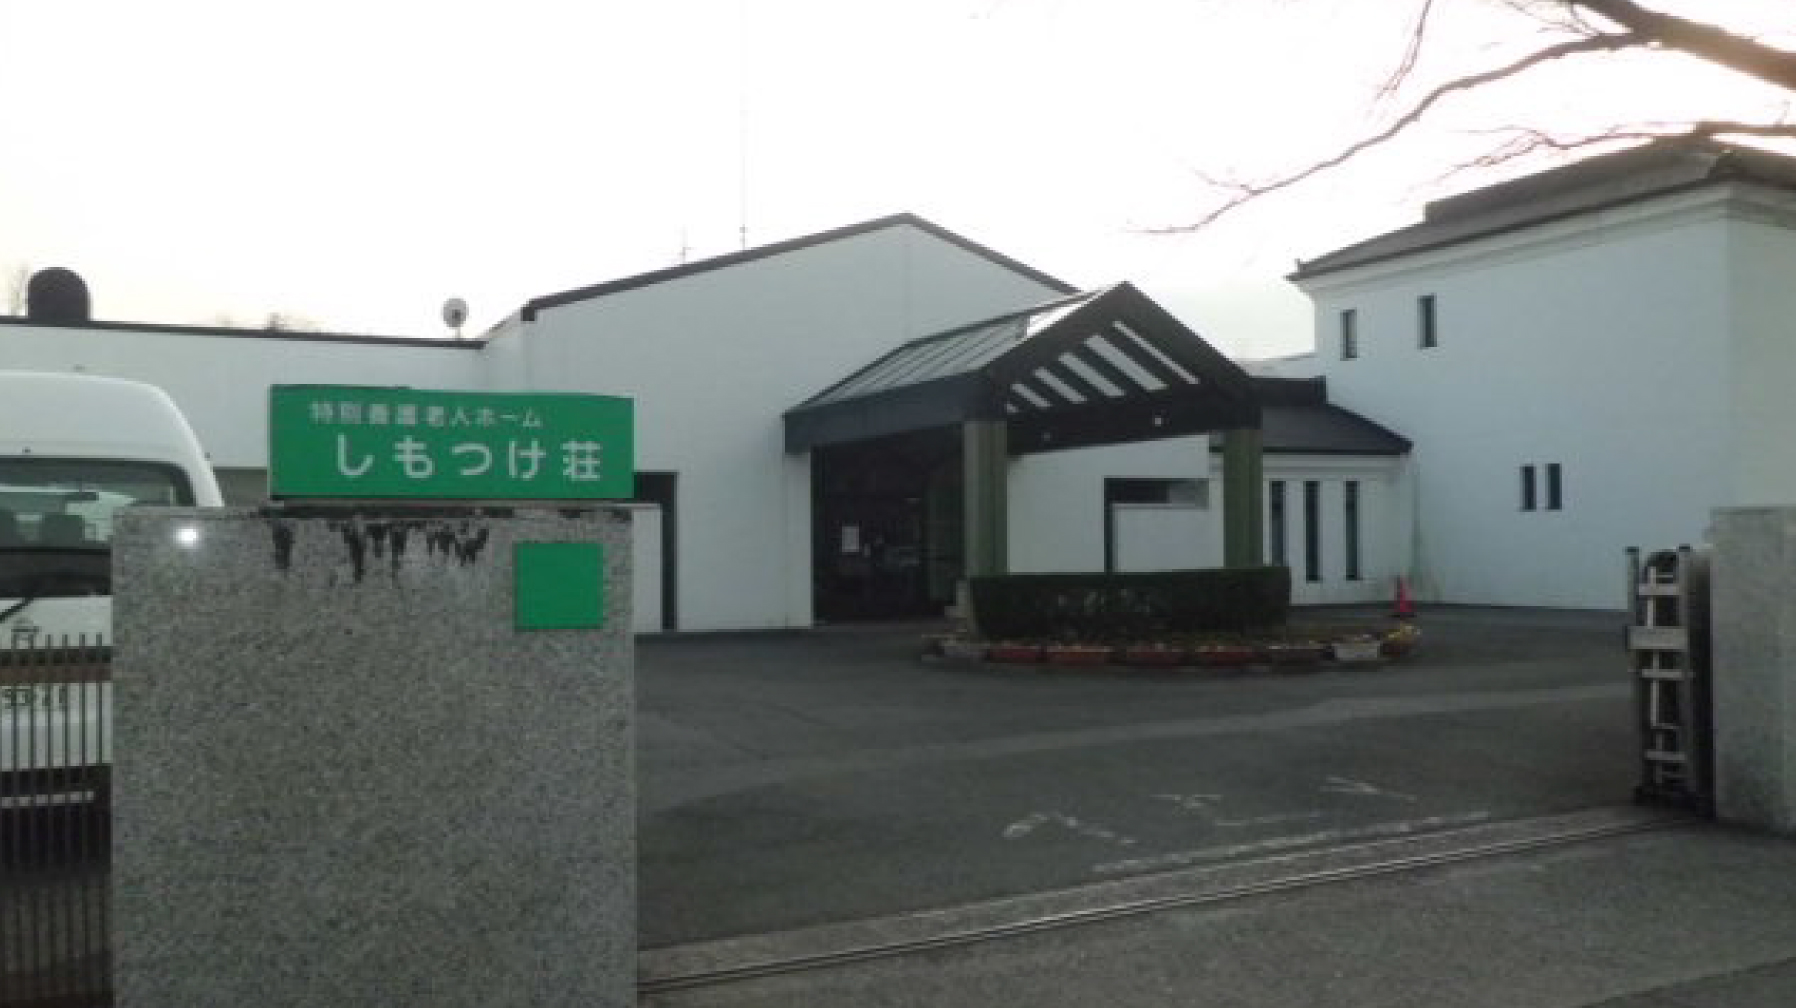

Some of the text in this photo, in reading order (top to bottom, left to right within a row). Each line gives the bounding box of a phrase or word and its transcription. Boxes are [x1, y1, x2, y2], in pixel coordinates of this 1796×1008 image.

[309, 401, 543, 427] 特別養護老人ホーム
[337, 433, 601, 481] しもつけ荘
